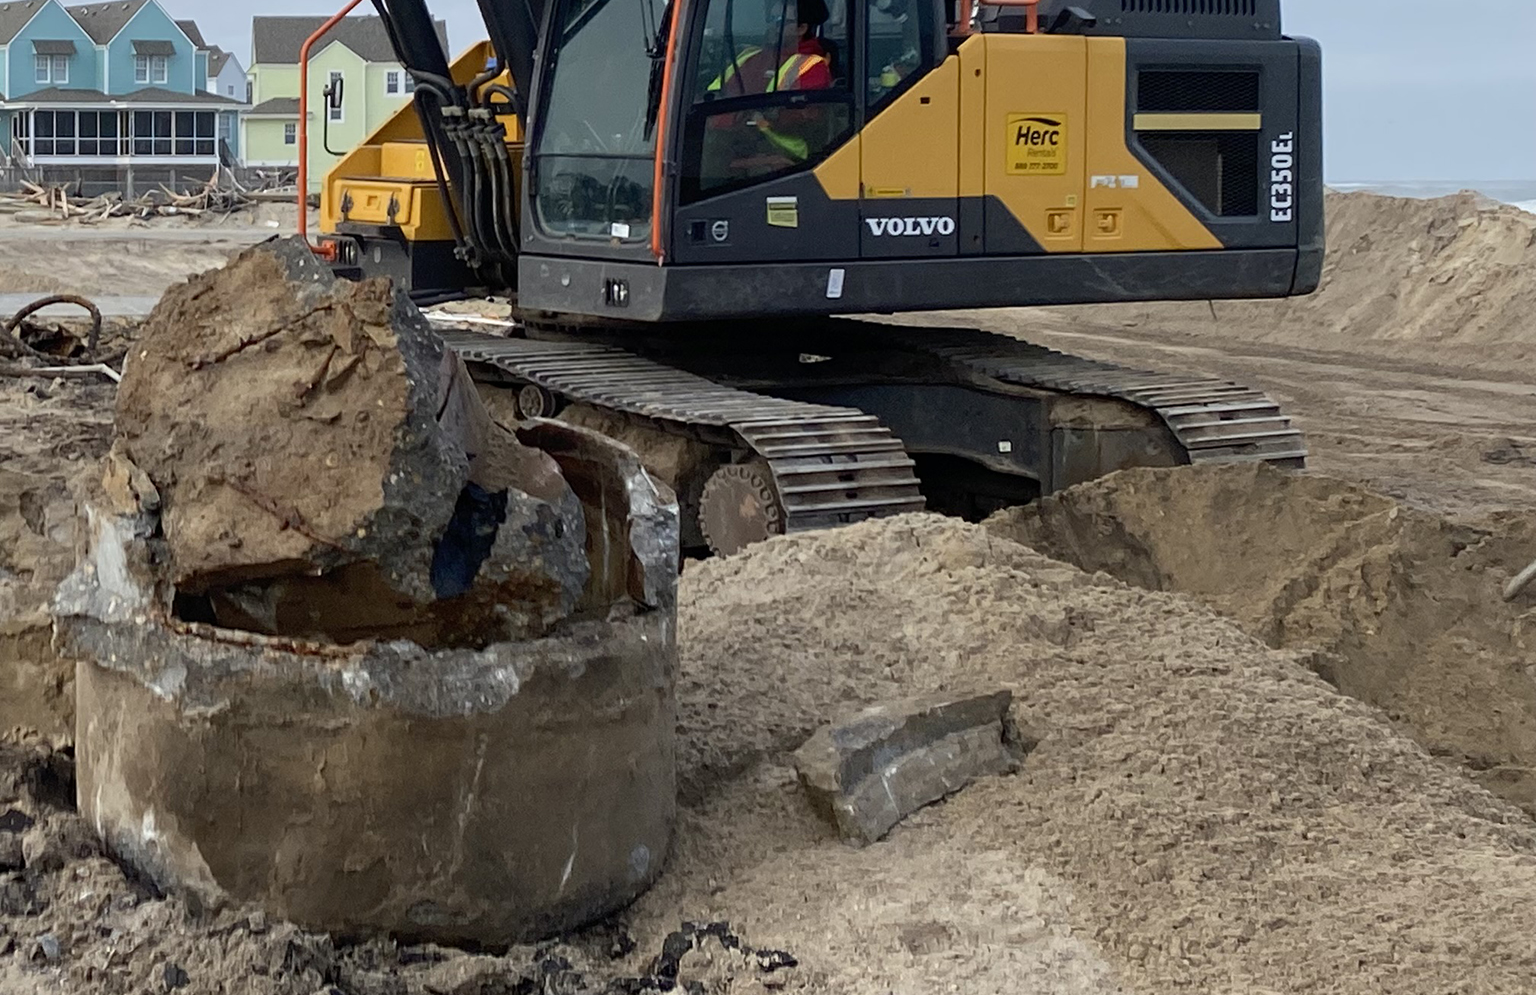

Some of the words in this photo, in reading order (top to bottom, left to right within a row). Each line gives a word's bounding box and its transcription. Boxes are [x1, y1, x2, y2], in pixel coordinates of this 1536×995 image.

[1015, 125, 1060, 146] Herc
[1270, 131, 1293, 221] EC350EL
[865, 216, 955, 236] VOLVO
